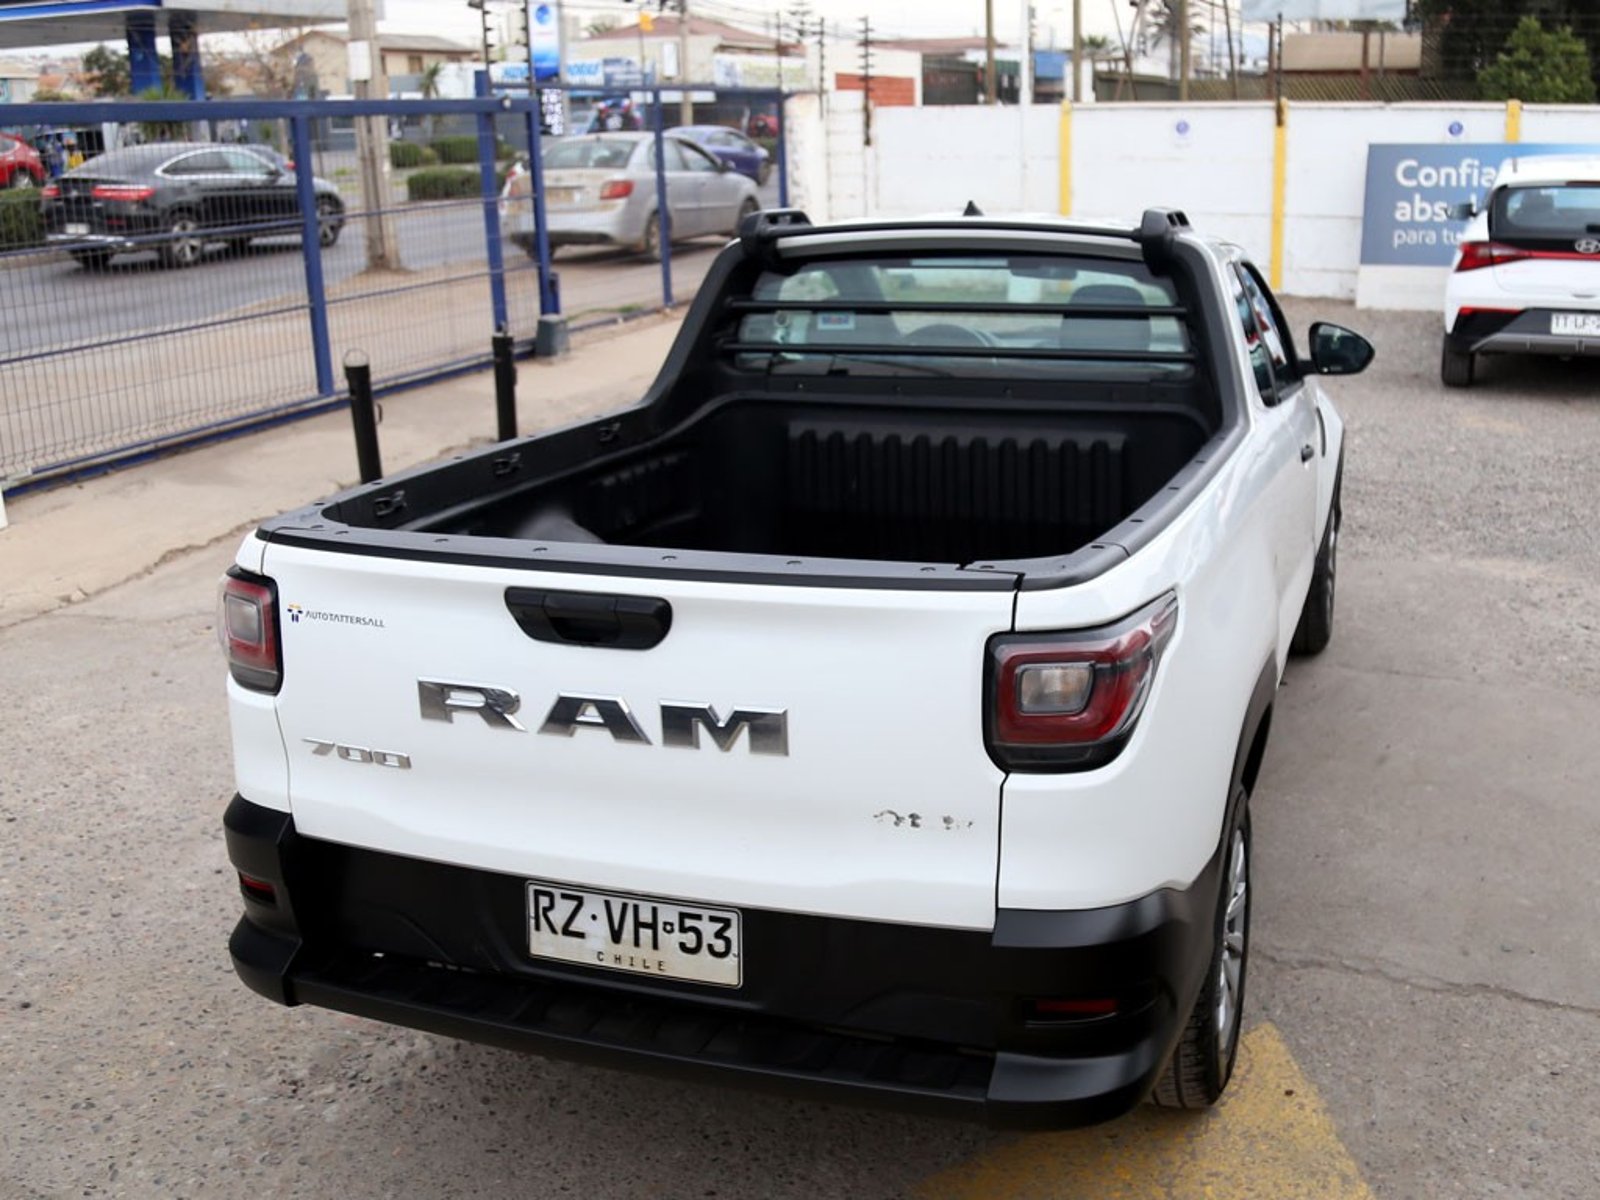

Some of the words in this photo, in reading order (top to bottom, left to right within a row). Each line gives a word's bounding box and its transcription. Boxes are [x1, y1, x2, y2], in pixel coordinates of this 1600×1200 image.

[1393, 229, 1437, 250] para
[305, 609, 385, 629] AUTOTATTERSALL
[416, 675, 790, 757] RAM
[301, 736, 412, 769] 700
[596, 950, 666, 972] CHILE
